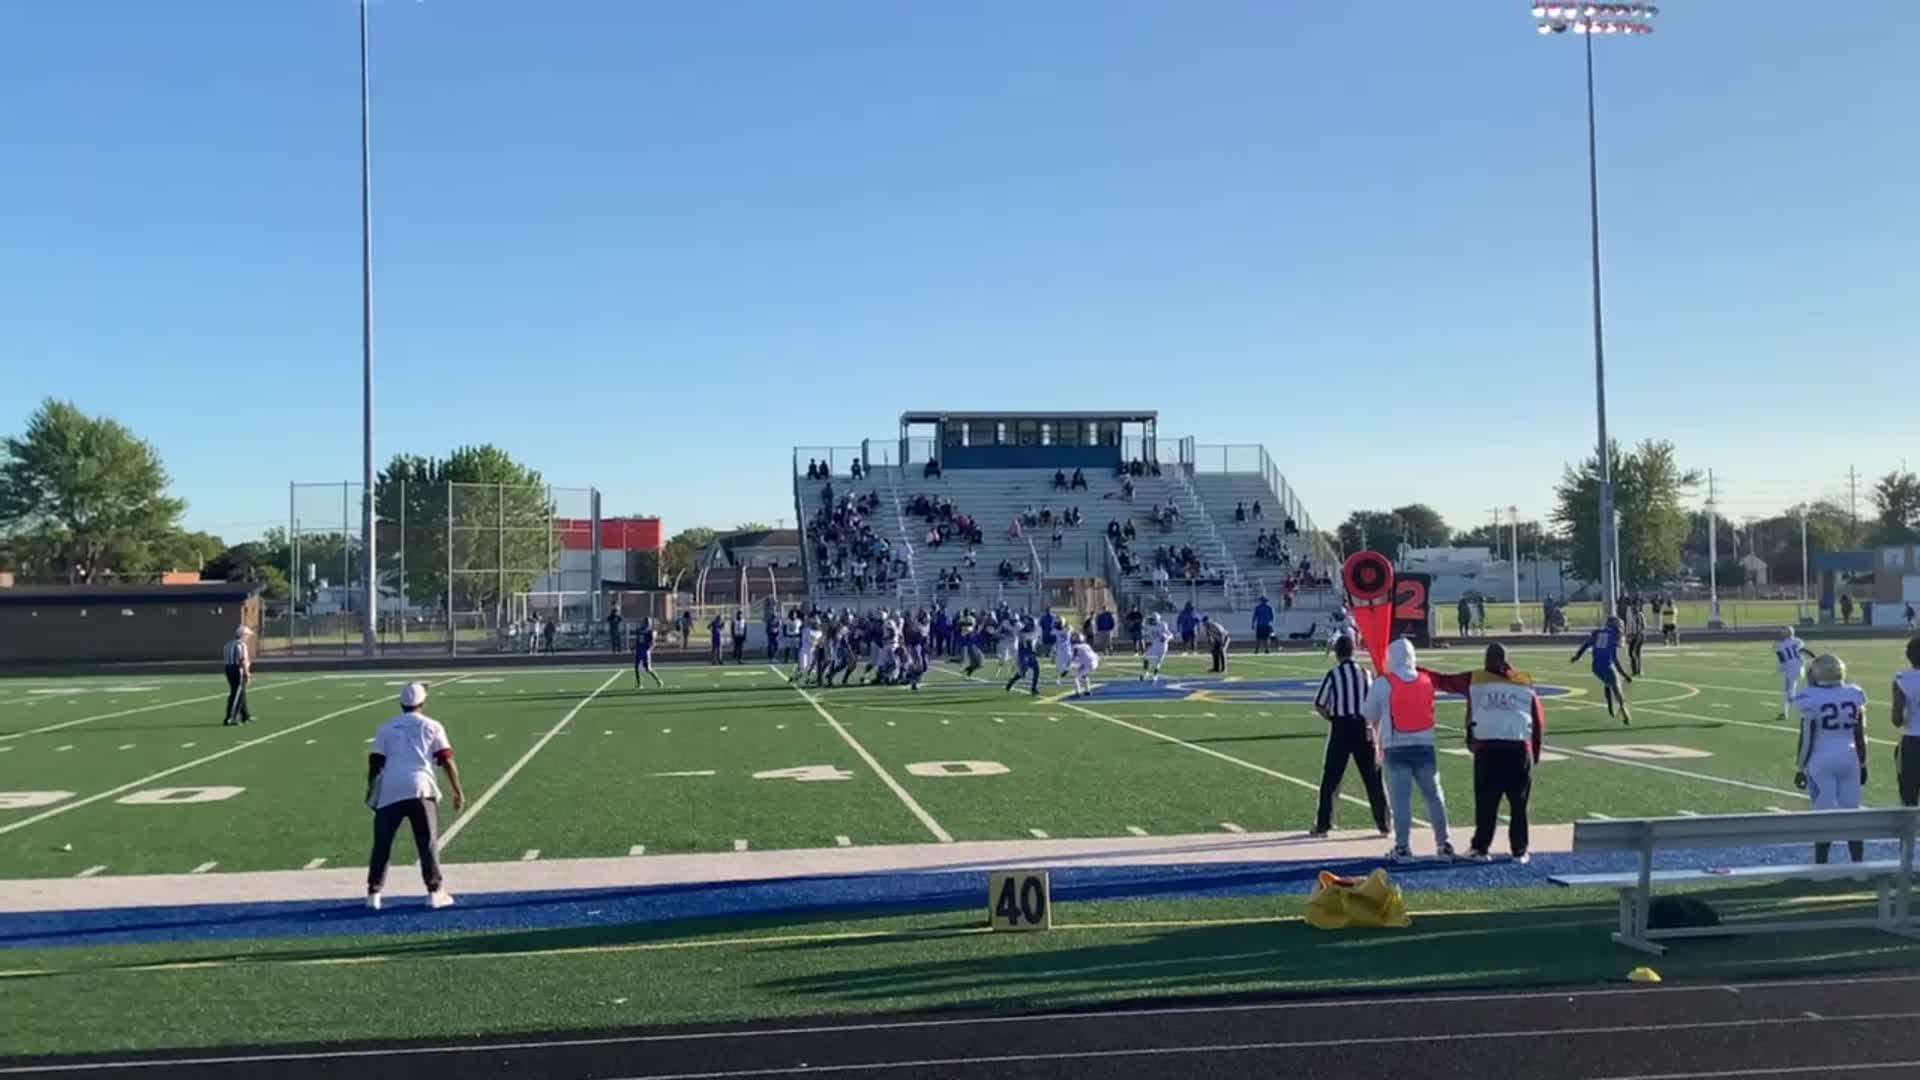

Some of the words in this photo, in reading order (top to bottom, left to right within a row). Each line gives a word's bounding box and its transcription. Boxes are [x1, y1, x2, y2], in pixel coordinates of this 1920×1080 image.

[1395, 580, 1425, 619] 2
[1820, 702, 1857, 730] 23
[995, 876, 1045, 925] 40
